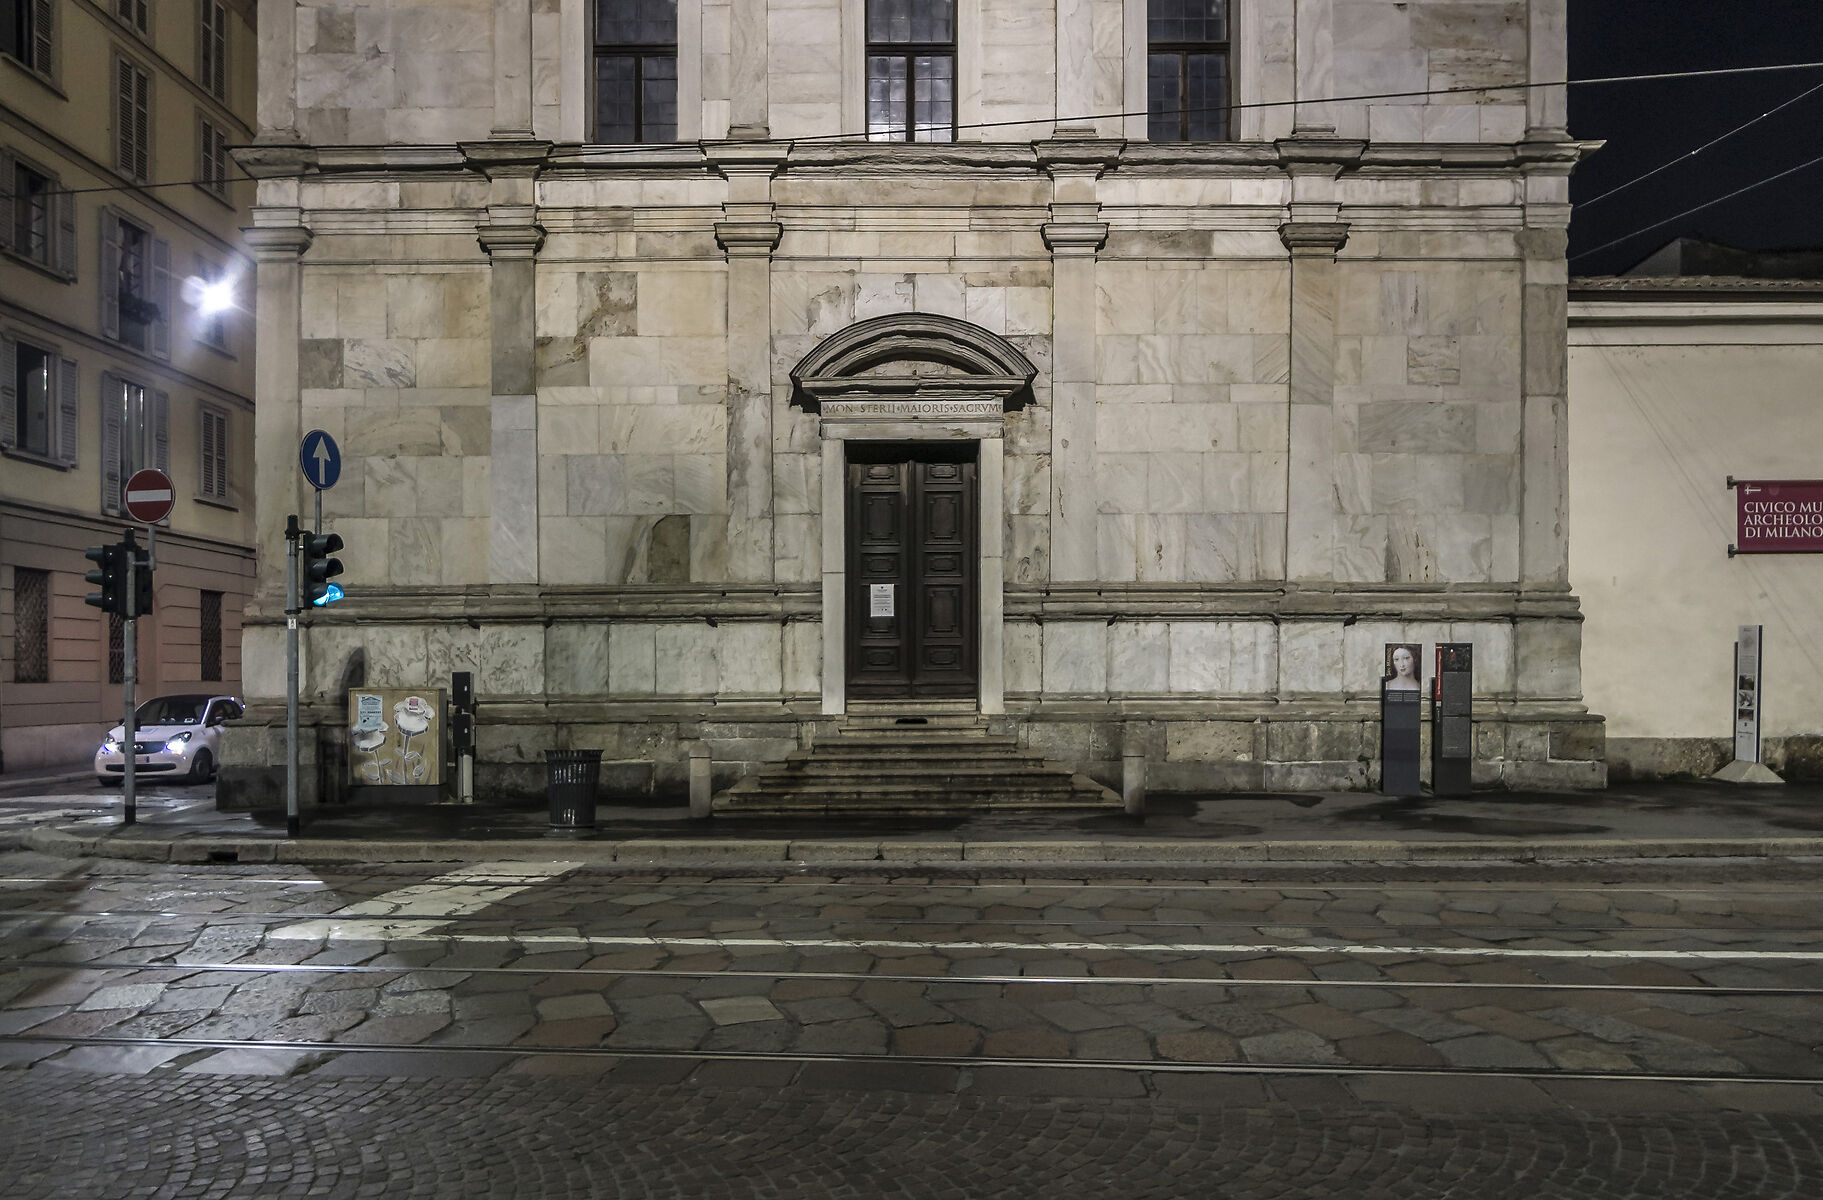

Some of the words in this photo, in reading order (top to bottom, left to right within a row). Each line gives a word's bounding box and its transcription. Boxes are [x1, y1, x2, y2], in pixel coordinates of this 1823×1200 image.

[826, 403, 896, 413] MONSTERII
[900, 403, 949, 413] MAIORIS
[1744, 501, 1796, 513] CIVICO
[1745, 526, 1761, 538] DI
[1765, 526, 1823, 538] MILANO
